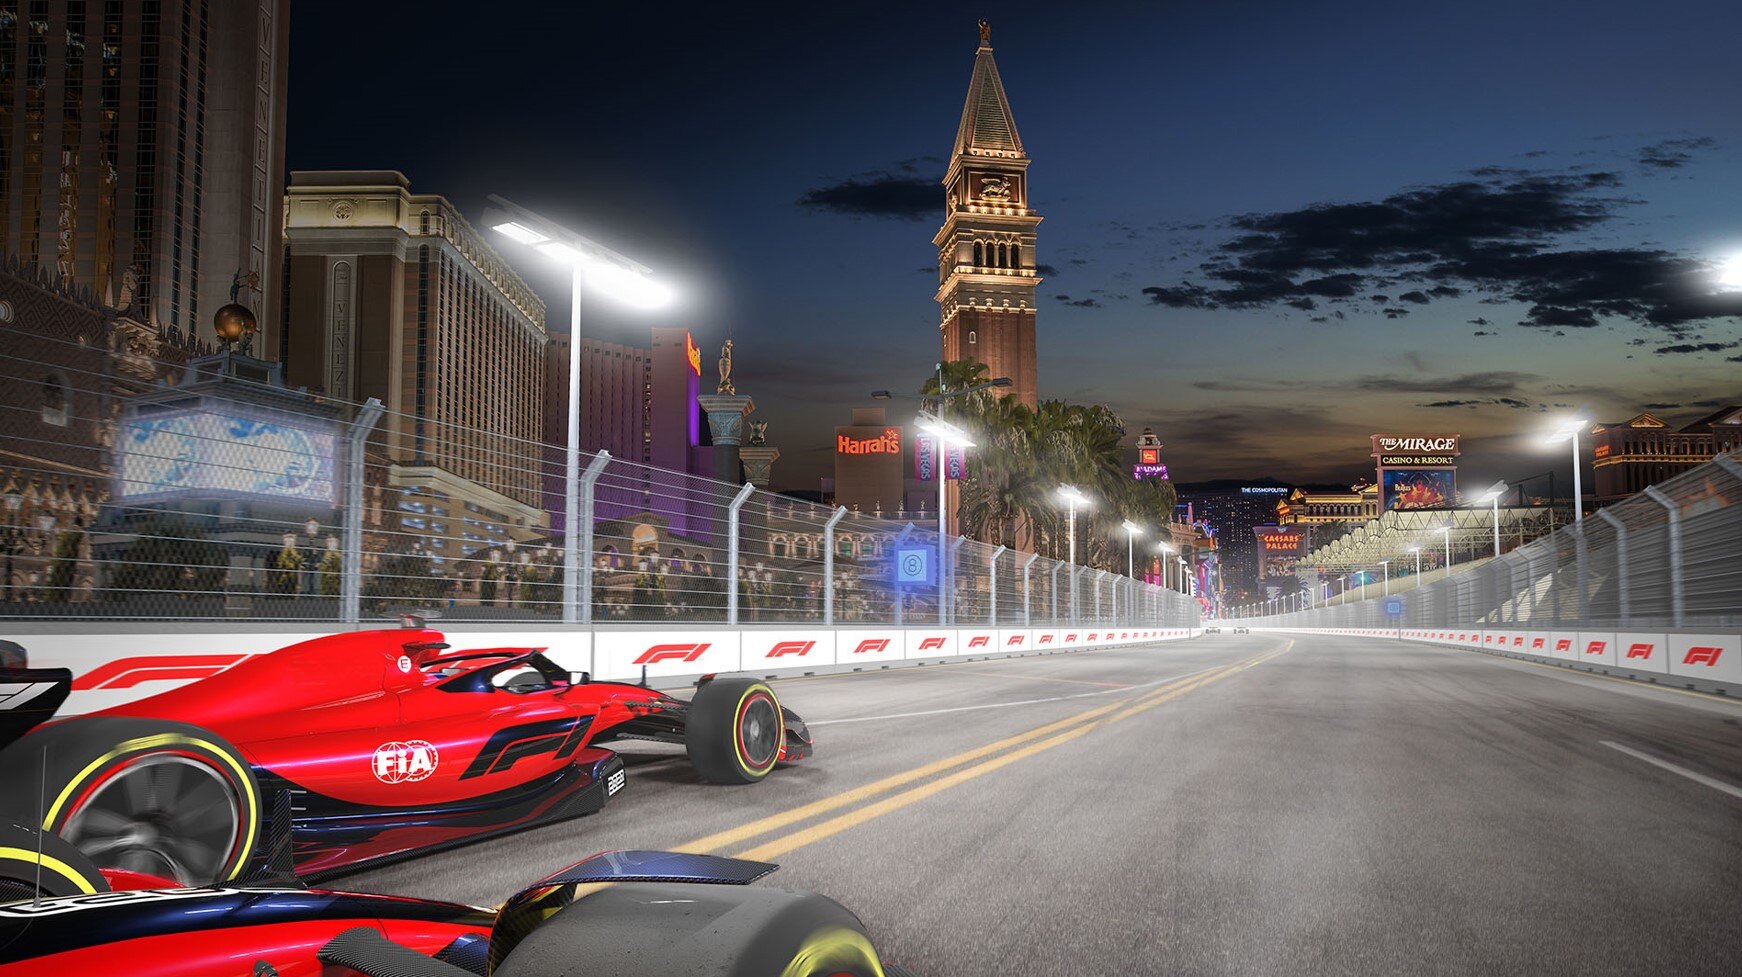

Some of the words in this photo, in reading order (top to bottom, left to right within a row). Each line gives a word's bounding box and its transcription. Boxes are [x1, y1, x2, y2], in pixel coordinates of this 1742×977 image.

[1380, 438, 1396, 446] THE
[1385, 438, 1455, 452] MIRAGE
[920, 453, 931, 479] VEGAS
[908, 558, 917, 573] 8
[632, 643, 712, 664] F1
[765, 641, 816, 658] F1
[1682, 646, 1724, 667] F1
[400, 658, 409, 669] E
[458, 714, 597, 781] F1
